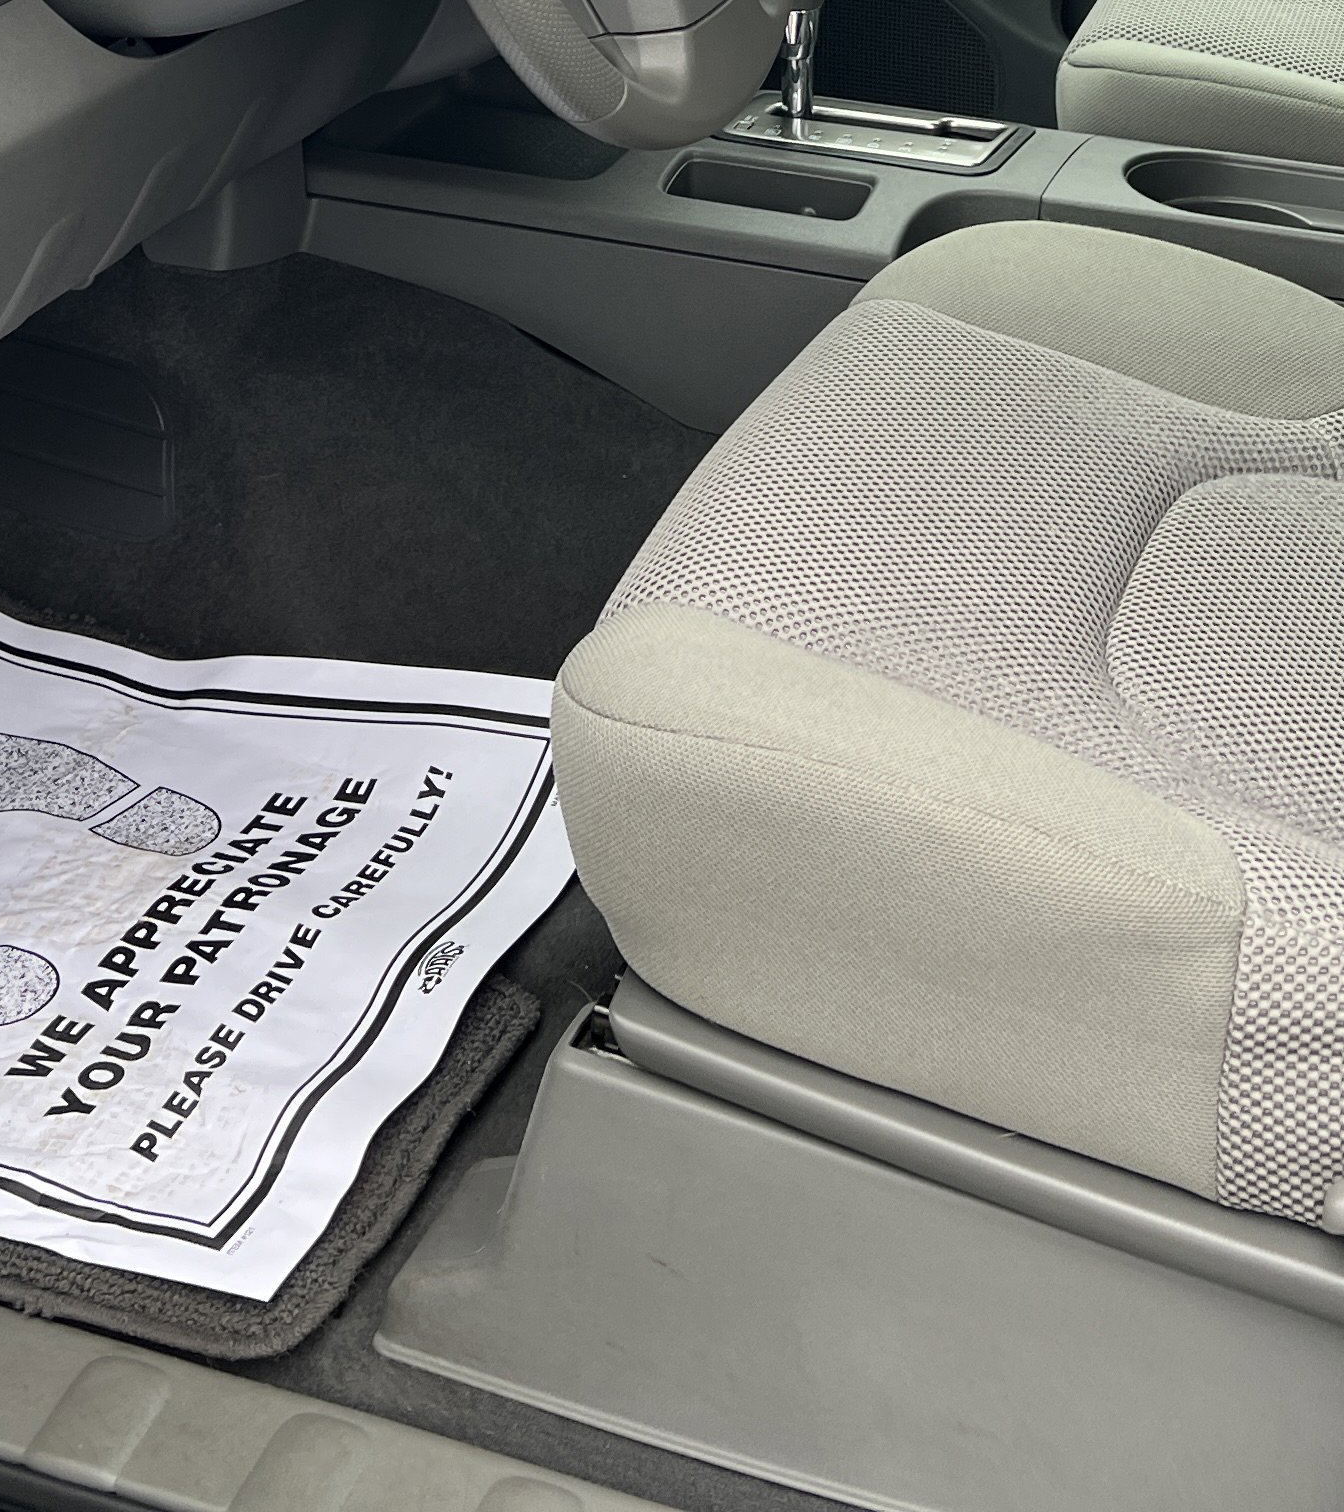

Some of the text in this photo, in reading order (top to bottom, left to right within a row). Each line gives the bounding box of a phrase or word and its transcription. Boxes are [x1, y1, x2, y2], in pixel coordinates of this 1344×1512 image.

[3, 792, 308, 1077] WE APPRECIATE
[43, 777, 378, 1118] YOUR PATRONAGE
[130, 765, 454, 1163] PLEASE DRIVE CAREFULLY!
